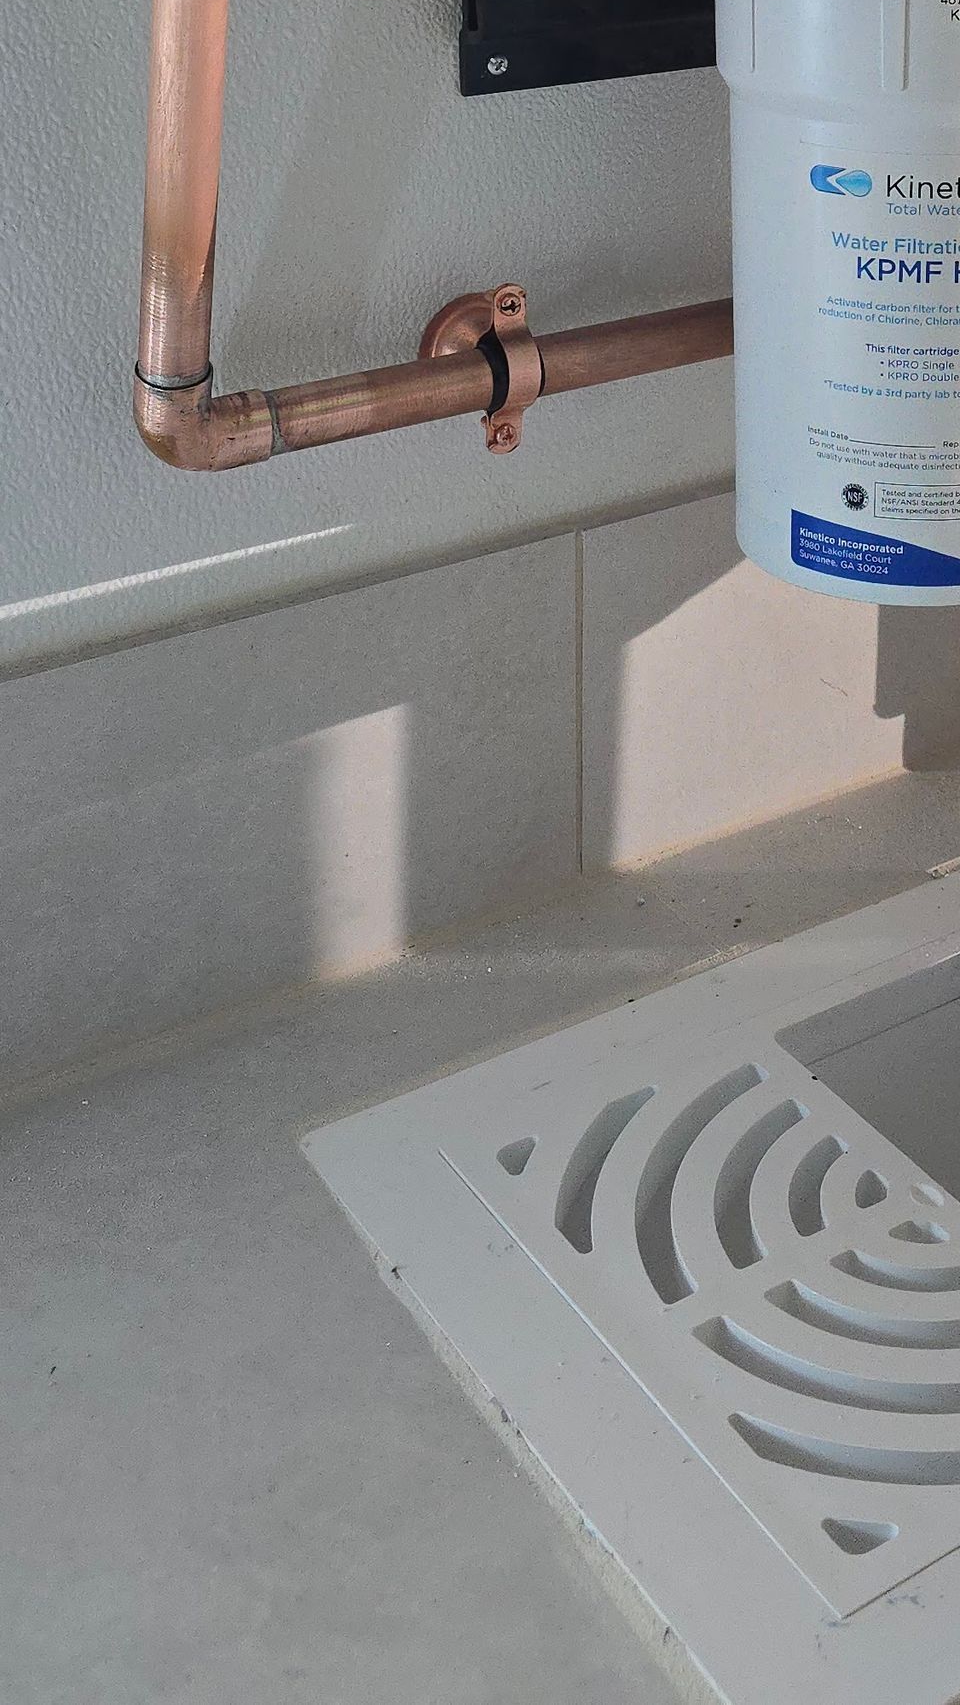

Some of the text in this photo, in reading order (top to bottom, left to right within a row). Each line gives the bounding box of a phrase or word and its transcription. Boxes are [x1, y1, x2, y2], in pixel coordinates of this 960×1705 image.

[886, 202, 921, 216] Total
[831, 231, 888, 252] Water
[857, 256, 943, 283] KPMF
[826, 295, 873, 310] Activated
[875, 302, 910, 313] carbon
[913, 304, 936, 314] filter
[939, 304, 952, 313] for
[818, 306, 862, 321] reduction
[865, 313, 876, 322] of
[878, 314, 923, 327] Chlorine,
[865, 343, 886, 354] This
[888, 345, 910, 355] filter
[913, 346, 960, 357] cartridge
[887, 359, 955, 371] KPRO Single
[887, 371, 960, 382] KPRO Double
[861, 385, 874, 396] by
[885, 388, 902, 398] 3rd
[904, 390, 932, 400] party
[934, 390, 950, 399] lab
[807, 425, 849, 441] Install Date
[809, 438, 820, 446] Do
[821, 443, 835, 451] not
[836, 445, 850, 453] use
[852, 447, 871, 456] with
[872, 450, 897, 459] water
[899, 452, 917, 460] that
[817, 451, 842, 463] quality
[844, 457, 876, 467] without
[878, 462, 920, 471] adequate
[846, 491, 863, 503] NSF
[881, 488, 906, 497] Tested
[908, 490, 922, 498] and
[923, 489, 954, 498] certified
[881, 497, 919, 506] NSF/ANSI
[921, 498, 955, 507] Standard
[881, 506, 904, 514] claims
[905, 507, 938, 516] specified
[799, 527, 904, 555] Kinetico Incorporated
[799, 538, 892, 565] 3980 Lakefield Court
[840, 560, 855, 570] GA
[857, 563, 889, 575] 30024
